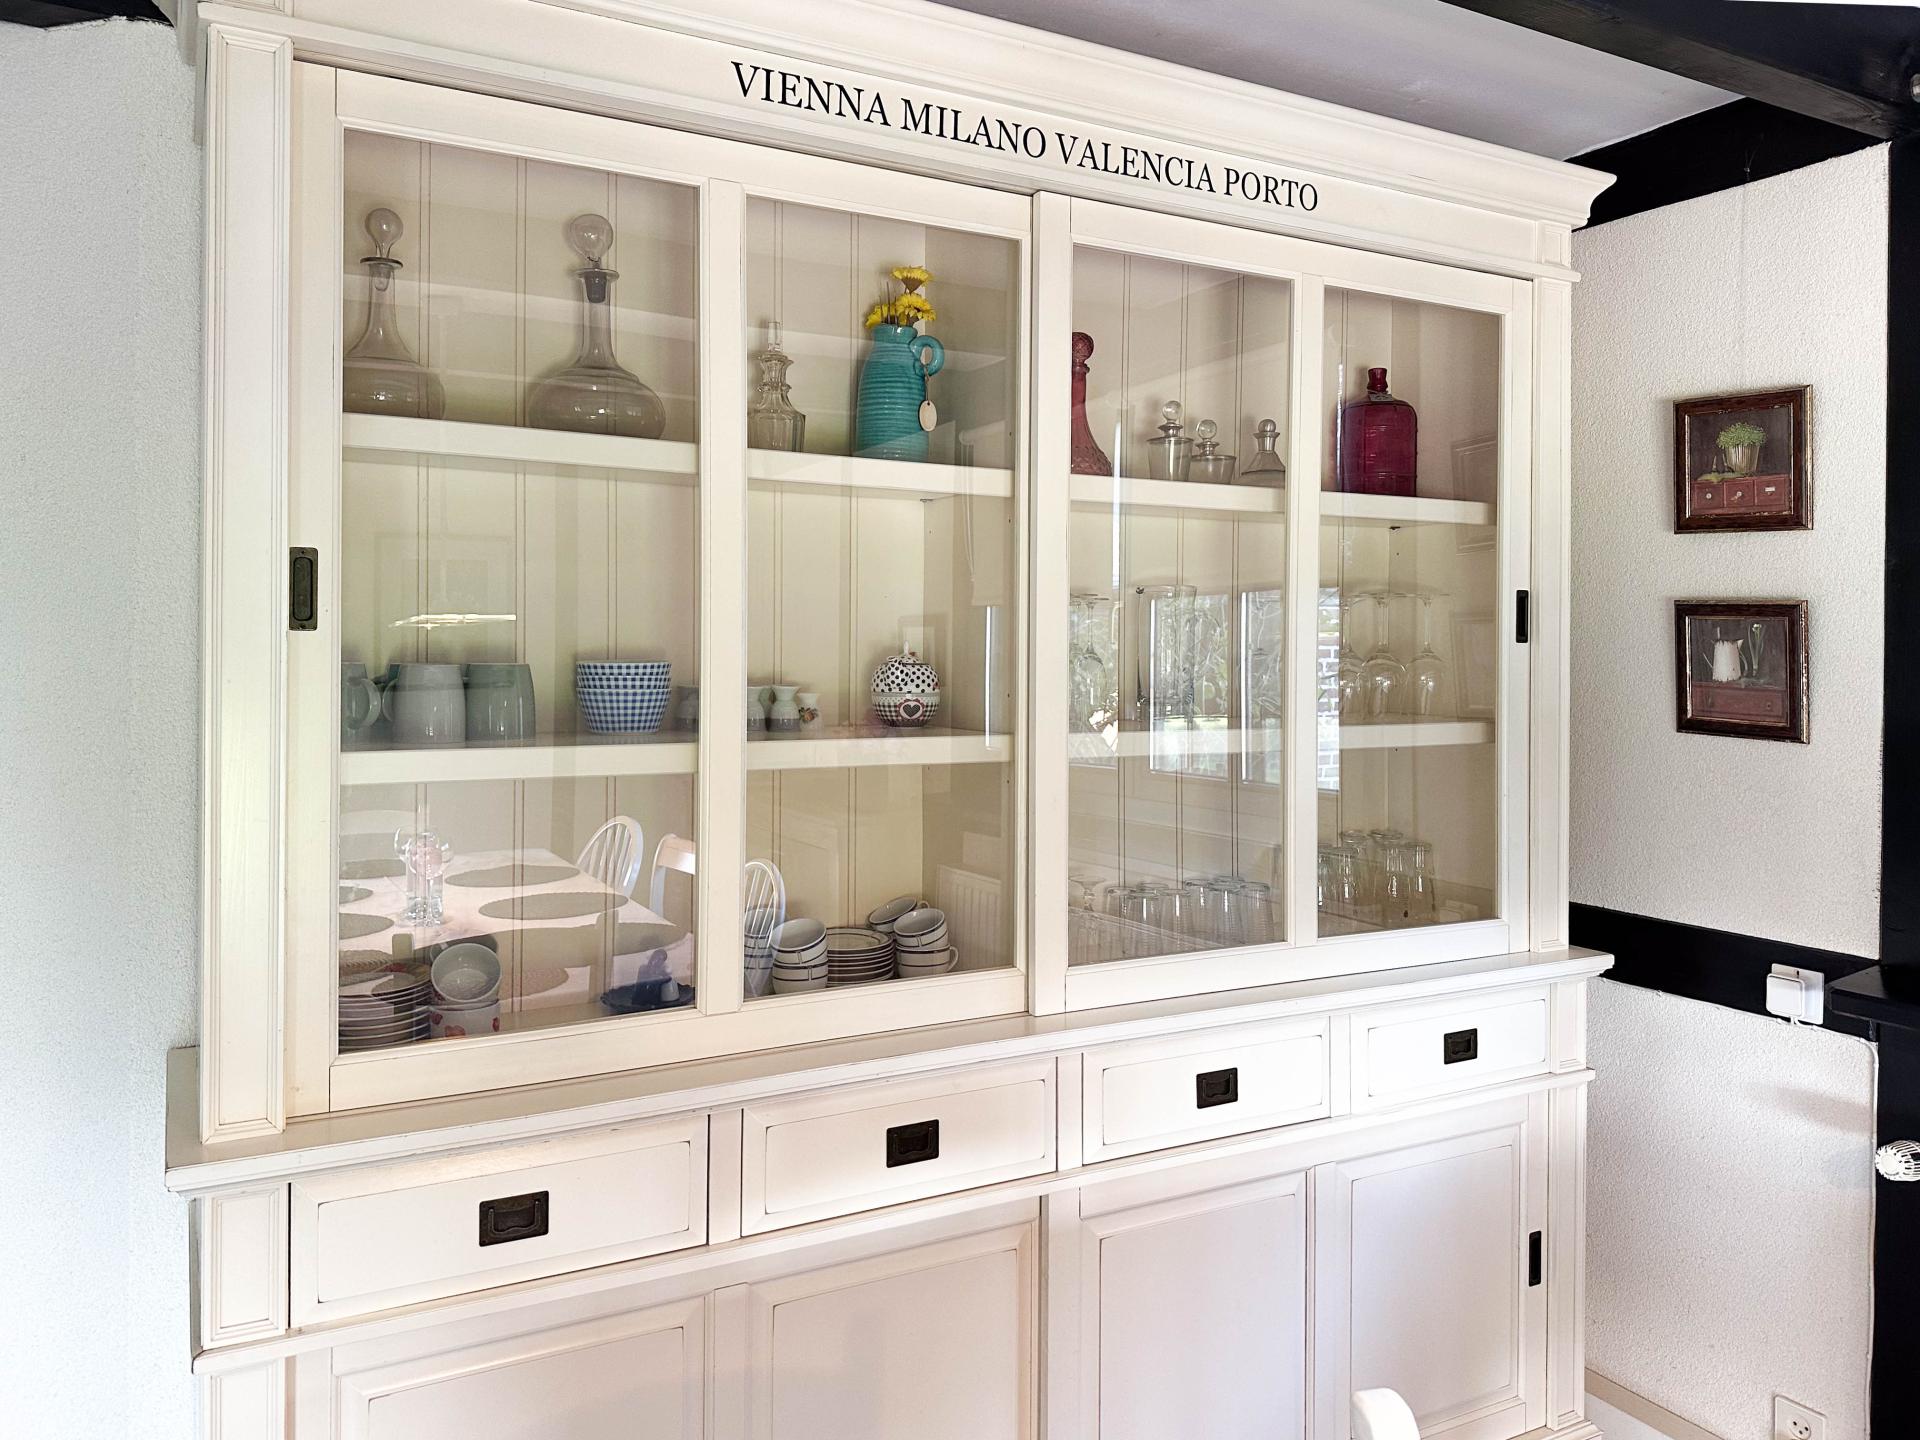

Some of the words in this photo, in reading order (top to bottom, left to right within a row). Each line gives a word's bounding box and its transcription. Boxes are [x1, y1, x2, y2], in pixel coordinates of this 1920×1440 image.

[731, 60, 892, 127] VIENNA
[901, 97, 1047, 159] MILANO
[1055, 132, 1217, 193] VALENCIA
[1224, 167, 1318, 212] PORTO
